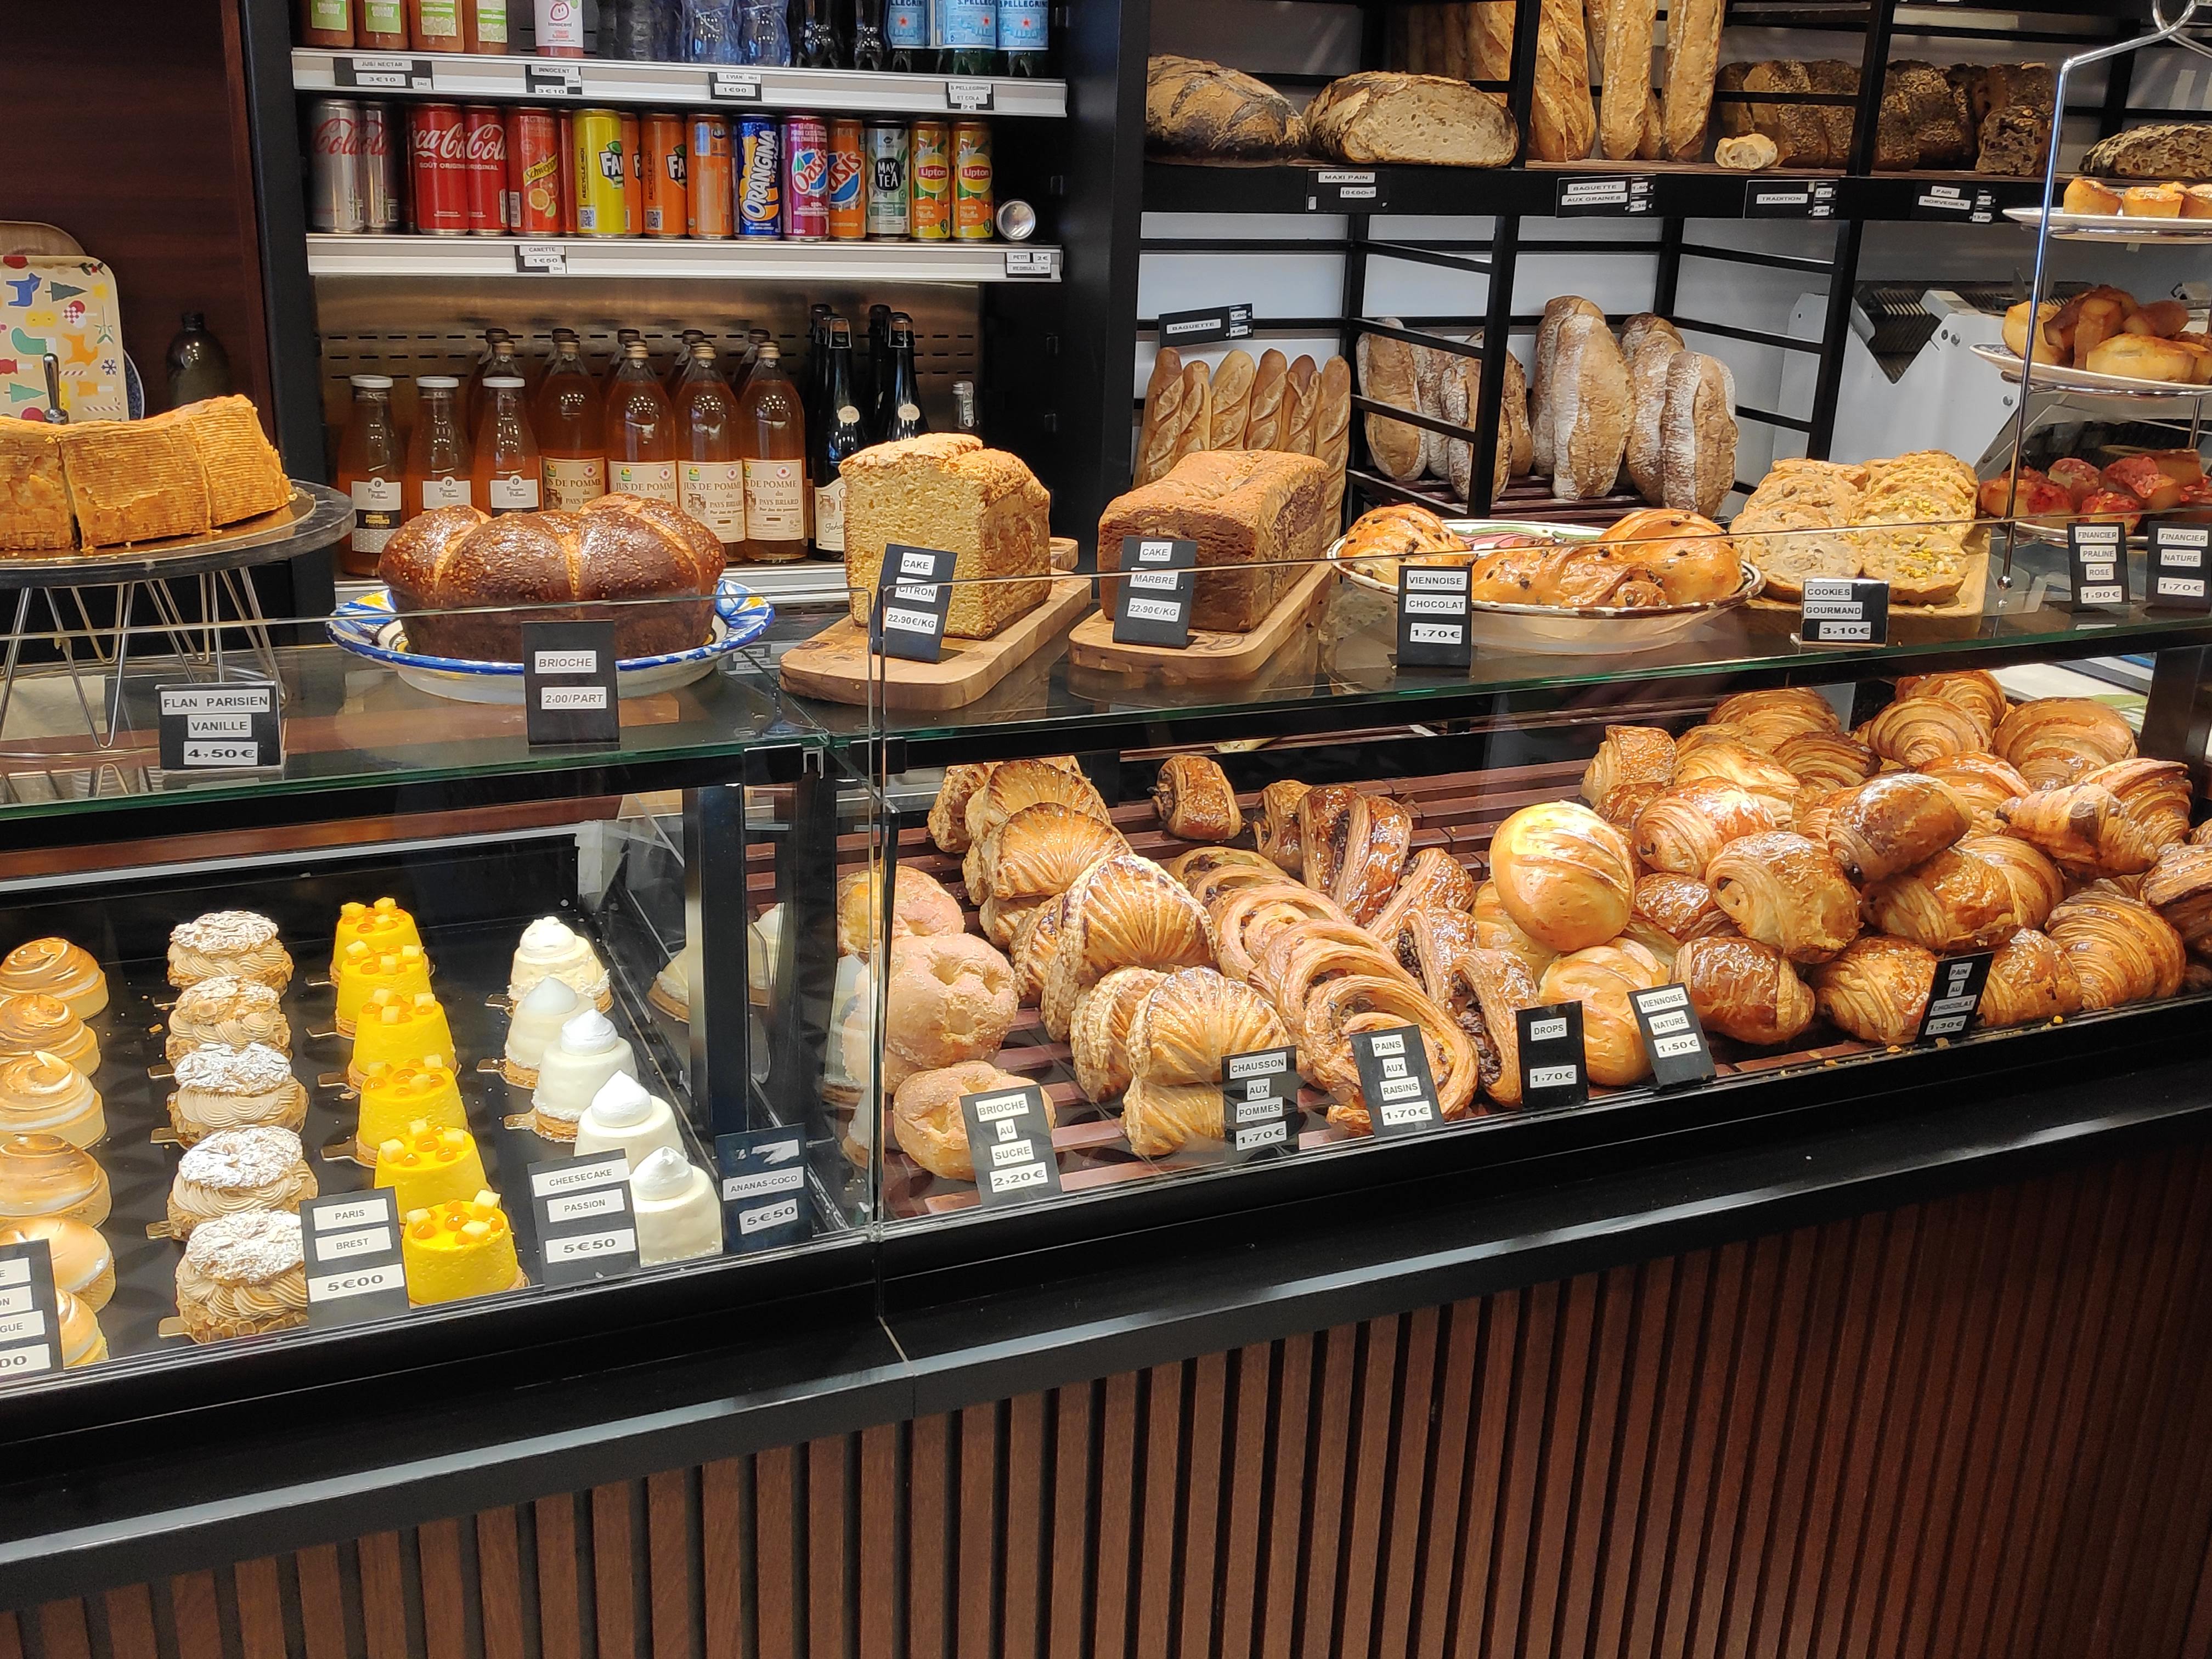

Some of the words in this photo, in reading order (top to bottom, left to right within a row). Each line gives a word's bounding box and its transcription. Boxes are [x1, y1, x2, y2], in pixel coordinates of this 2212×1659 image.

[742, 130, 776, 218] ORANGINA
[878, 162, 896, 174] MAY
[921, 167, 946, 177] Lipton
[963, 167, 989, 177] Lipton
[878, 172, 899, 188] TEA
[1923, 199, 1965, 207] NORVEGIEN
[1172, 322, 1215, 331] BAGUETTE
[555, 478, 568, 487] DE
[570, 478, 602, 488] POMME
[616, 483, 630, 492] JUS
[630, 483, 644, 491] DE
[683, 482, 698, 492] JUS
[699, 481, 712, 490] DE
[749, 479, 761, 488] DE
[763, 479, 797, 489] POMME
[2076, 531, 2117, 539] FINANCIER
[2160, 533, 2206, 542] FINANCIER
[1142, 548, 1169, 557] CAKE
[2164, 554, 2198, 563] NATURE
[903, 560, 930, 570] CAKE
[2089, 568, 2110, 576] ROSE
[1133, 574, 1176, 585] MARBRE
[1408, 576, 1463, 585] VIENNOISE
[898, 584, 936, 597] CITRON
[1130, 604, 1177, 617] 22,90€/KG
[1408, 600, 1464, 610] CHOCOLAT
[1805, 606, 1861, 614] GOURMAND
[887, 614, 935, 629] 22,90€/KG
[1411, 629, 1460, 639] 1,70€
[538, 658, 593, 668] BRIOCHE
[163, 698, 198, 708] FLAN
[206, 696, 268, 707] PARISIEN
[544, 693, 604, 704] 2,00/PART
[190, 720, 248, 732] VANILLE
[187, 748, 255, 759] 4,50€
[1950, 968, 1968, 977] PAIN
[1640, 992, 1684, 1008] VIENNOISE
[1932, 999, 1973, 1012] CHOCOLAT
[1653, 1016, 1686, 1030] NATURE
[1533, 1024, 1564, 1036] DROPS
[1374, 1040, 1402, 1052] PAINS
[1658, 1039, 1699, 1053] 1,50€
[1231, 1058, 1285, 1074] CHAUSSON
[1385, 1063, 1405, 1073] AUX
[1531, 1071, 1574, 1083] 1,70€
[1249, 1084, 1268, 1096] AUX
[1382, 1082, 1419, 1096] RAISINS
[978, 1099, 1026, 1116] BRIOCHE
[1238, 1103, 1281, 1118] POMMES
[1384, 1106, 1429, 1120] 1,70€
[1000, 1125, 1014, 1136] AU
[1238, 1127, 1285, 1144] 1,70€
[994, 1145, 1031, 1160] SUCRE
[549, 1167, 613, 1187] CHEESECAKE
[992, 1169, 1046, 1187] 2,20€
[730, 1174, 798, 1193] ANANAS-COCO
[563, 1198, 606, 1213] PASSION
[334, 1209, 366, 1221] PARIS
[746, 1205, 796, 1227] 5€50
[335, 1237, 369, 1250] BREST
[562, 1237, 617, 1254] 5€50
[326, 1273, 385, 1292] 5€00
